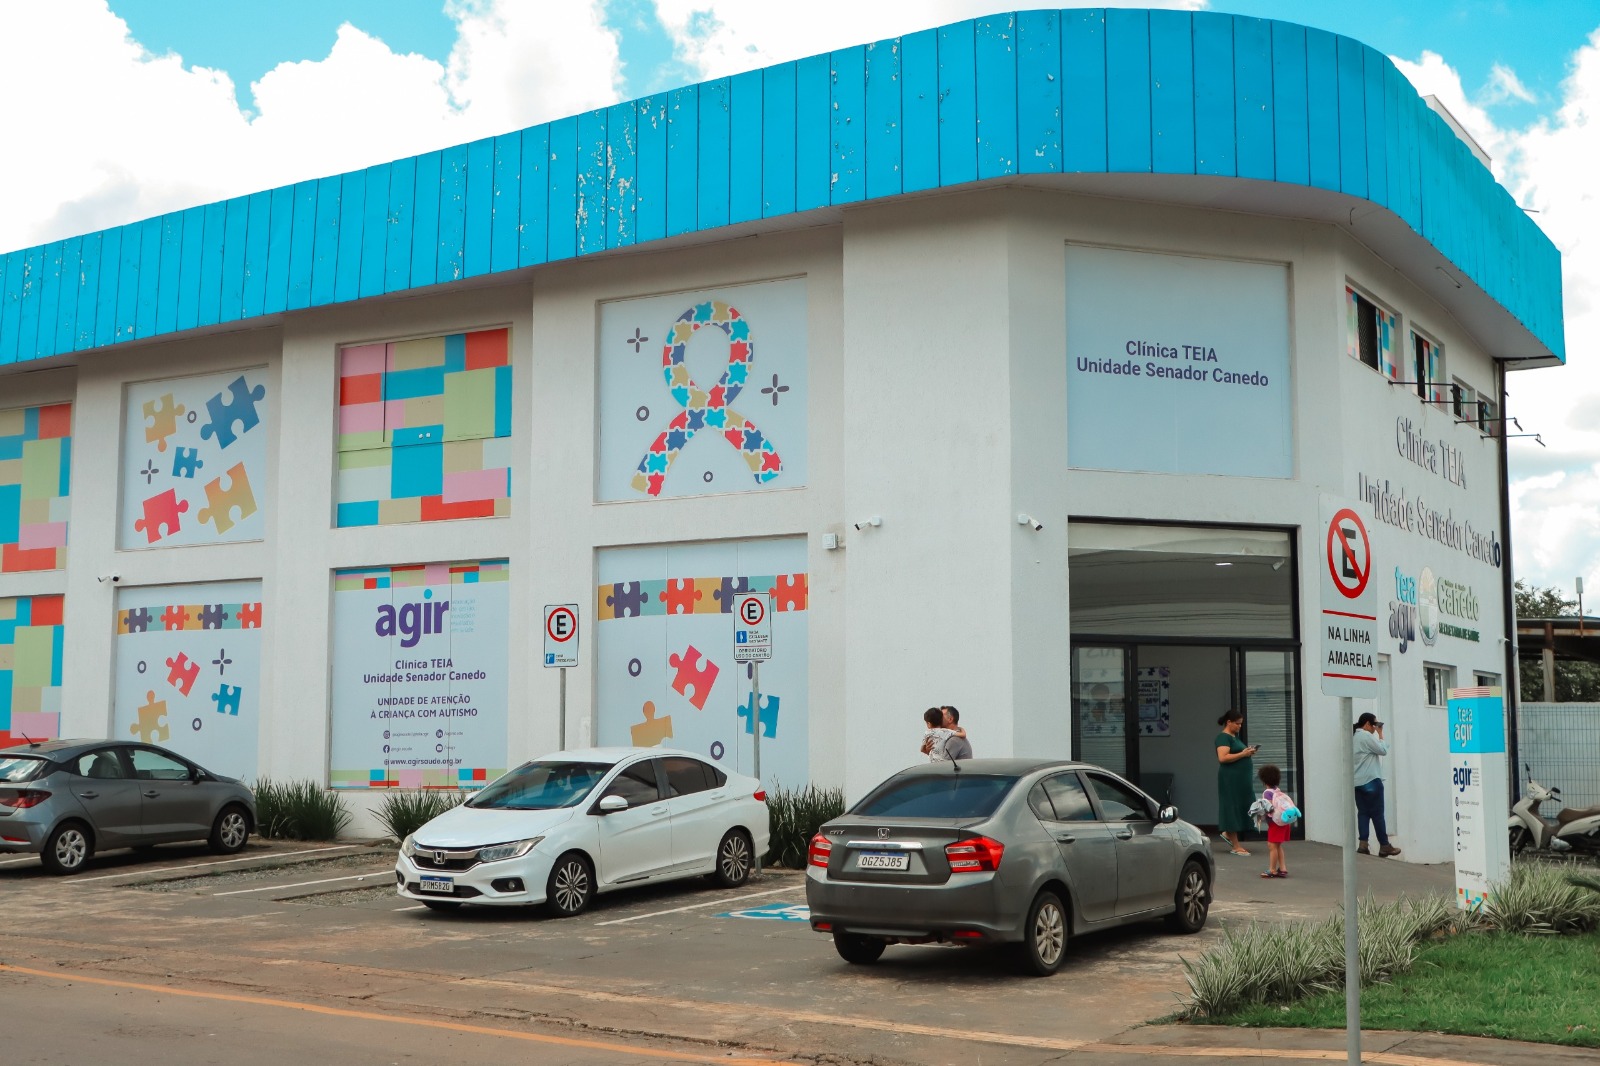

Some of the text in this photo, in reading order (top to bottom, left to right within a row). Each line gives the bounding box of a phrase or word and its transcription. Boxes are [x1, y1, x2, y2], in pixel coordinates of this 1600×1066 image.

[1125, 340, 1218, 363] Clínica TEIA
[1076, 356, 1269, 386] Unidade Senador Canedo
[1396, 416, 1467, 490] Clínica TEIA
[1358, 472, 1501, 568] Unidade Senador Canedo
[1437, 577, 1479, 621] Canedo
[375, 588, 450, 648] agir
[747, 603, 757, 619] E
[556, 614, 567, 635] E
[1328, 625, 1371, 645] NA LINHA
[1388, 601, 1416, 654] agir
[395, 658, 453, 670] Clínica TEIA
[1328, 650, 1373, 668] AMARELA
[363, 670, 486, 684] Unidade Senador Canedo
[377, 694, 471, 706] UNIDADE DE ATENÇÃO
[378, 709, 415, 719] CRIANÇA
[417, 709, 437, 718] COM
[439, 708, 478, 718] AUTISMO
[1454, 723, 1473, 748] agir
[390, 757, 462, 766] www.agirsaude.org.br
[1453, 760, 1472, 792] agir
[861, 856, 903, 867] OGZ5J85
